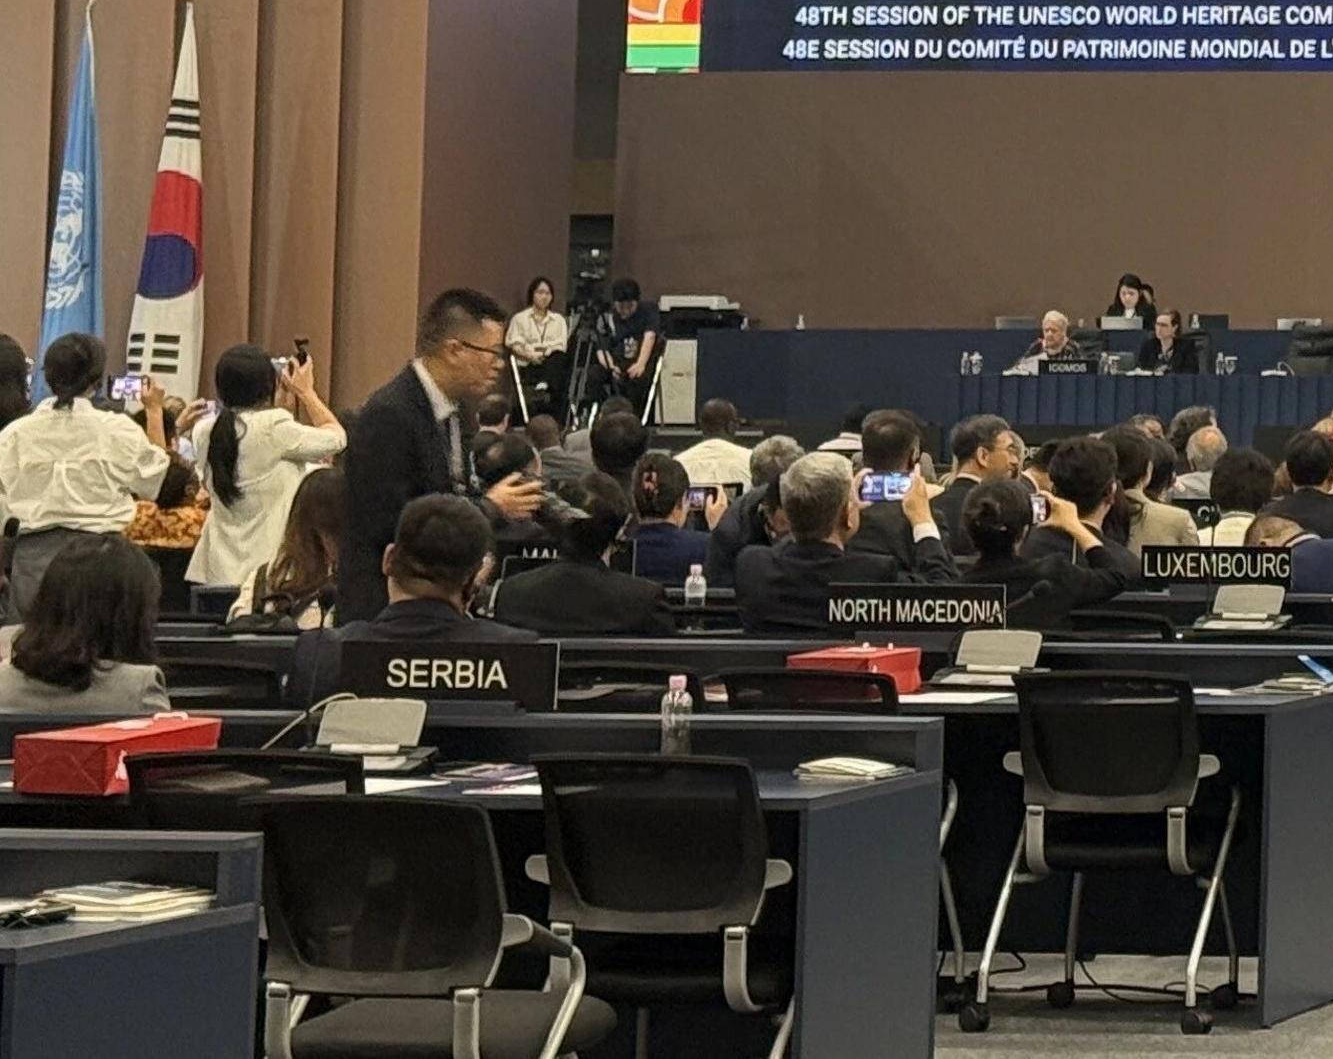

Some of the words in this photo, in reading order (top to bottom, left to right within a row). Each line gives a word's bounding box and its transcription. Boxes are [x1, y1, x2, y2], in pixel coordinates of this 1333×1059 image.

[795, 5, 847, 26] 48TH
[852, 5, 938, 26] SESSION
[943, 5, 969, 26] OF
[974, 5, 1014, 26] THE
[1018, 5, 1100, 26] UNESCO
[1105, 5, 1178, 26] WORLD
[1182, 5, 1281, 26] HERITAGE
[783, 39, 819, 59] 48E
[823, 39, 910, 59] SESSION
[915, 39, 943, 59] DU
[947, 35, 1025, 59] COMITÉ
[1030, 39, 1057, 59] DU
[1063, 39, 1186, 59] PATRIMOINE
[1190, 39, 1286, 59] MONDIAL
[1290, 39, 1316, 59] DE
[1048, 362, 1087, 373] ICOMOS
[1144, 551, 1290, 579] LUXEMBOURG
[829, 598, 892, 623] NORTH
[895, 598, 1004, 625] MACEDONIA
[386, 657, 509, 690] SERBIA
